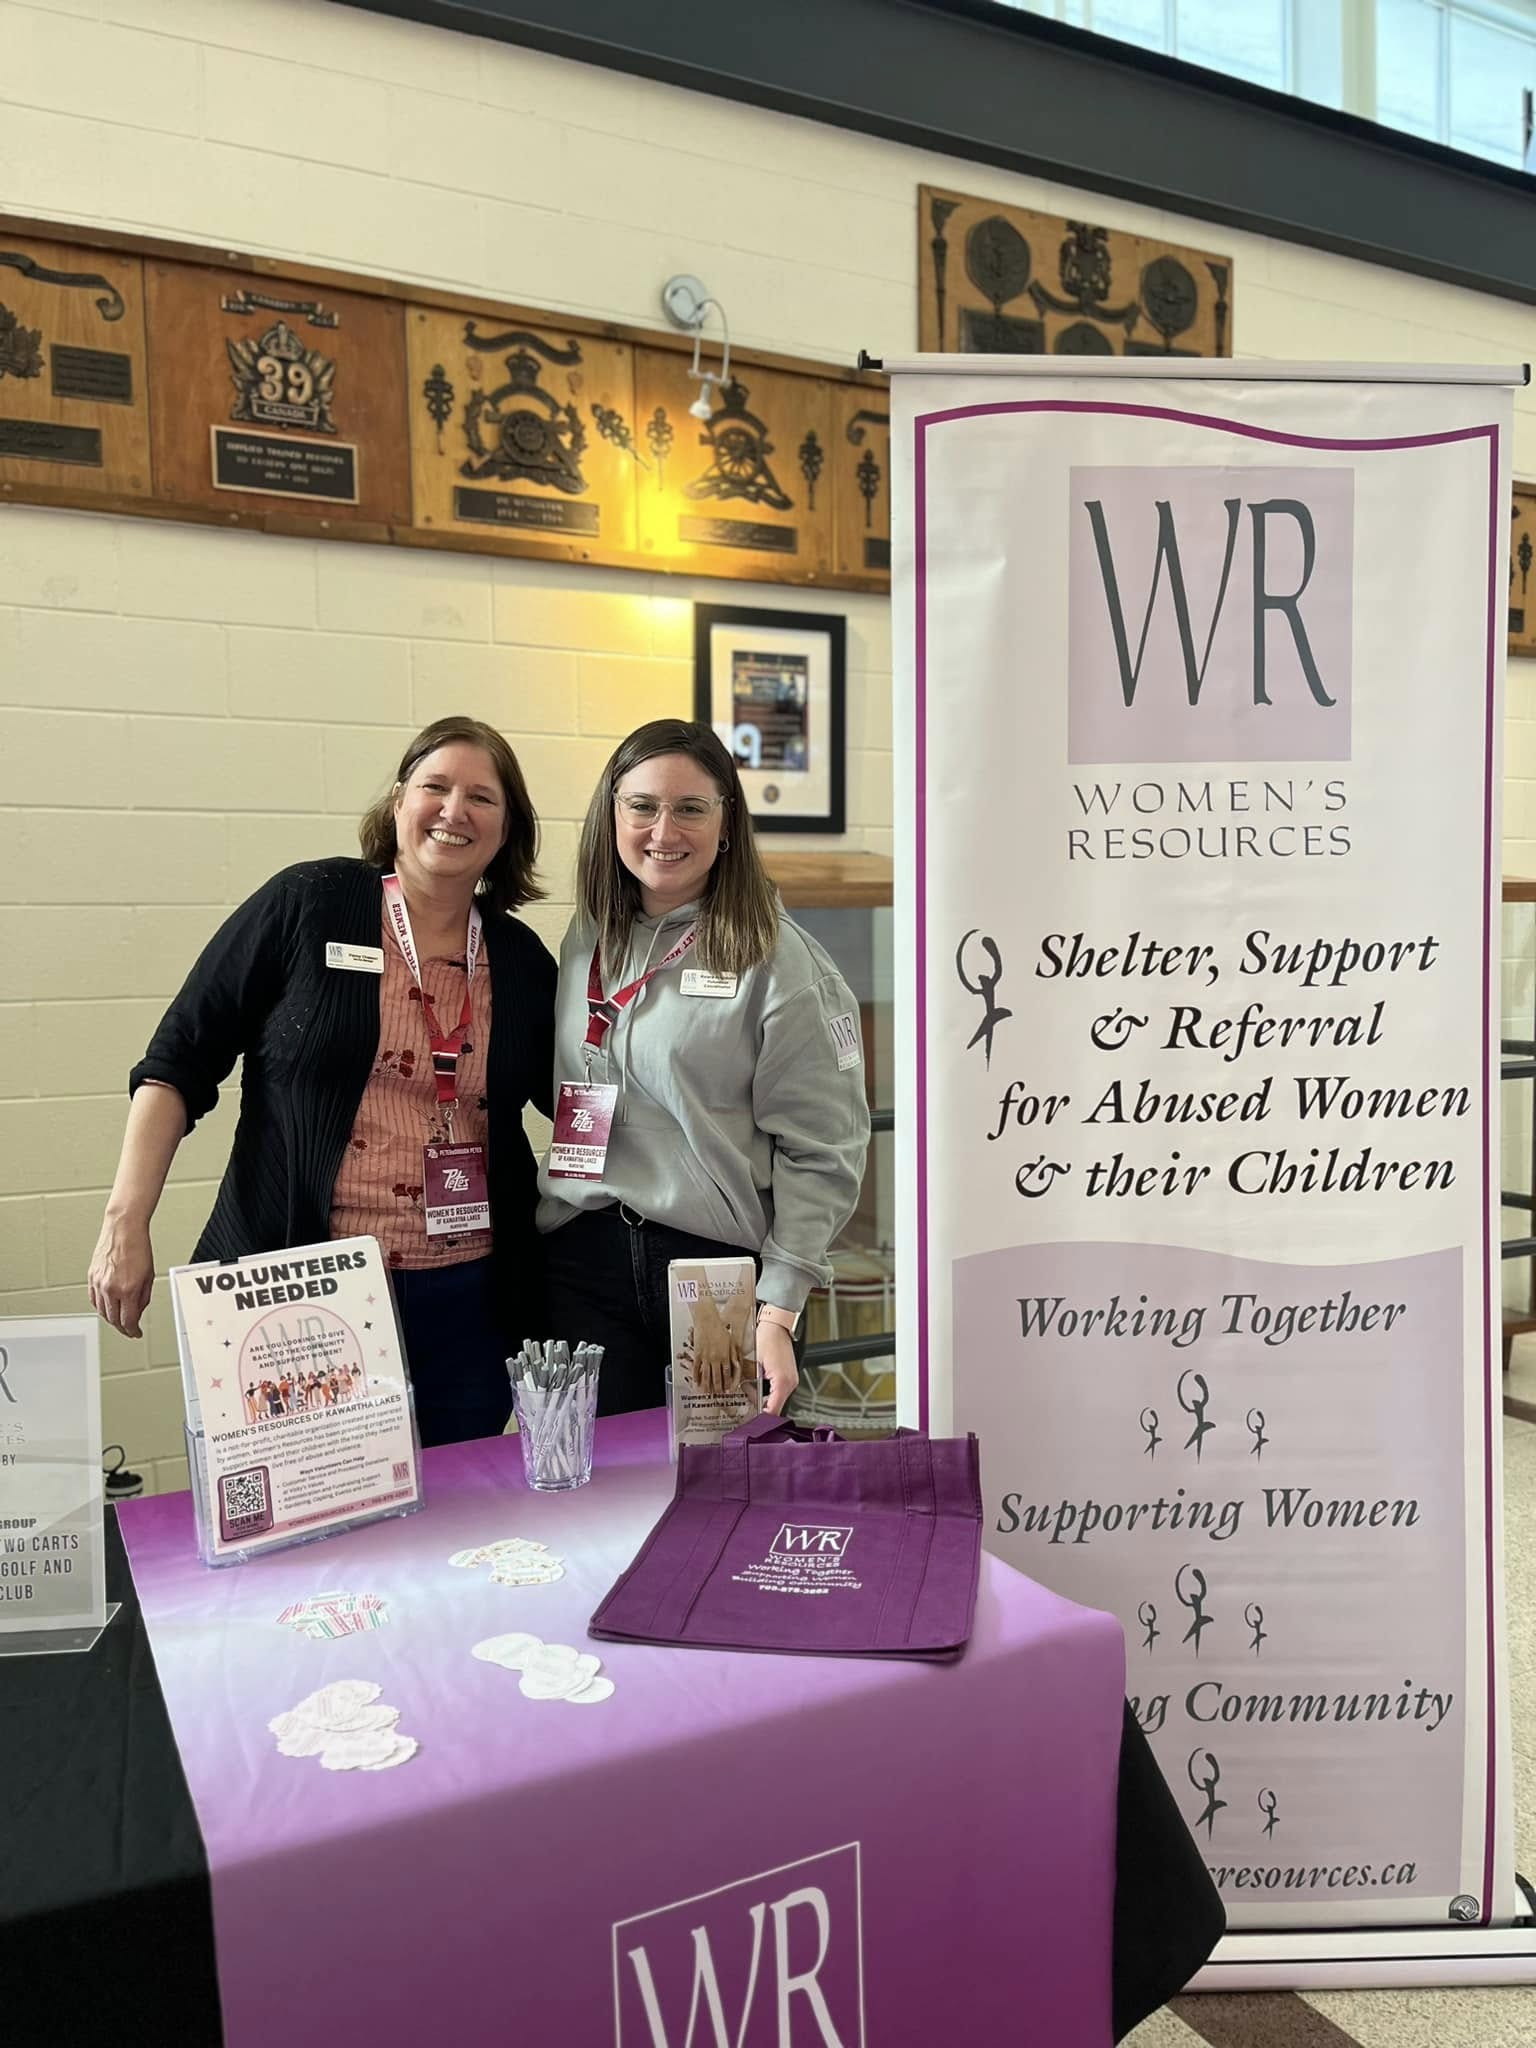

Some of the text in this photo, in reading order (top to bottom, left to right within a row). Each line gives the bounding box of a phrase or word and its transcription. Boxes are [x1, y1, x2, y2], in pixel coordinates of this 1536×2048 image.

[257, 355, 314, 405] 39
[263, 405, 307, 419] CANADA
[1084, 497, 1338, 707] WR
[1072, 779, 1349, 816] WOMEN'S
[1067, 825, 1352, 860] RESOURCES
[1035, 930, 1440, 987] Shelter, Support
[1090, 1000, 1386, 1063] & Referral
[986, 1076, 1472, 1141] for Abused Women
[576, 1148, 606, 1158] RESOURCES
[1014, 1146, 1457, 1198] & their Children
[427, 1203, 489, 1219] WOMEN'S RESOURCES
[195, 1249, 367, 1296] VOLUNTEERS
[234, 1275, 338, 1311] NEEDED
[678, 1282, 698, 1298] WR
[1016, 1291, 1407, 1348] Working Together
[249, 1329, 344, 1353] ARE YOU LOOKING TO GIVE
[252, 1337, 344, 1361] BACK TO THE COMMUNITY
[258, 1346, 342, 1369] AND SUPPORT WOMEN?
[681, 1393, 712, 1401] Women's
[692, 1401, 725, 1409] Kawartha
[212, 1394, 400, 1444] WOMEN'S RESOURCES OF KAWARTHA LAKES
[2, 1454, 16, 1466] BY
[0, 1518, 37, 1530] ROUP
[229, 1514, 252, 1529] SCAN
[252, 1511, 265, 1522] ME
[996, 1487, 1421, 1544] Supporting Women
[0, 1534, 80, 1553] WO CARTS
[784, 1527, 842, 1551] WR
[1, 1558, 73, 1577] GOLF AND
[764, 1558, 841, 1568] RESOURCES
[768, 1554, 841, 1562] WOMEN'S
[748, 1564, 856, 1577] Working Together
[1185, 1679, 1454, 1732] Community
[627, 1886, 845, 2048] WR
